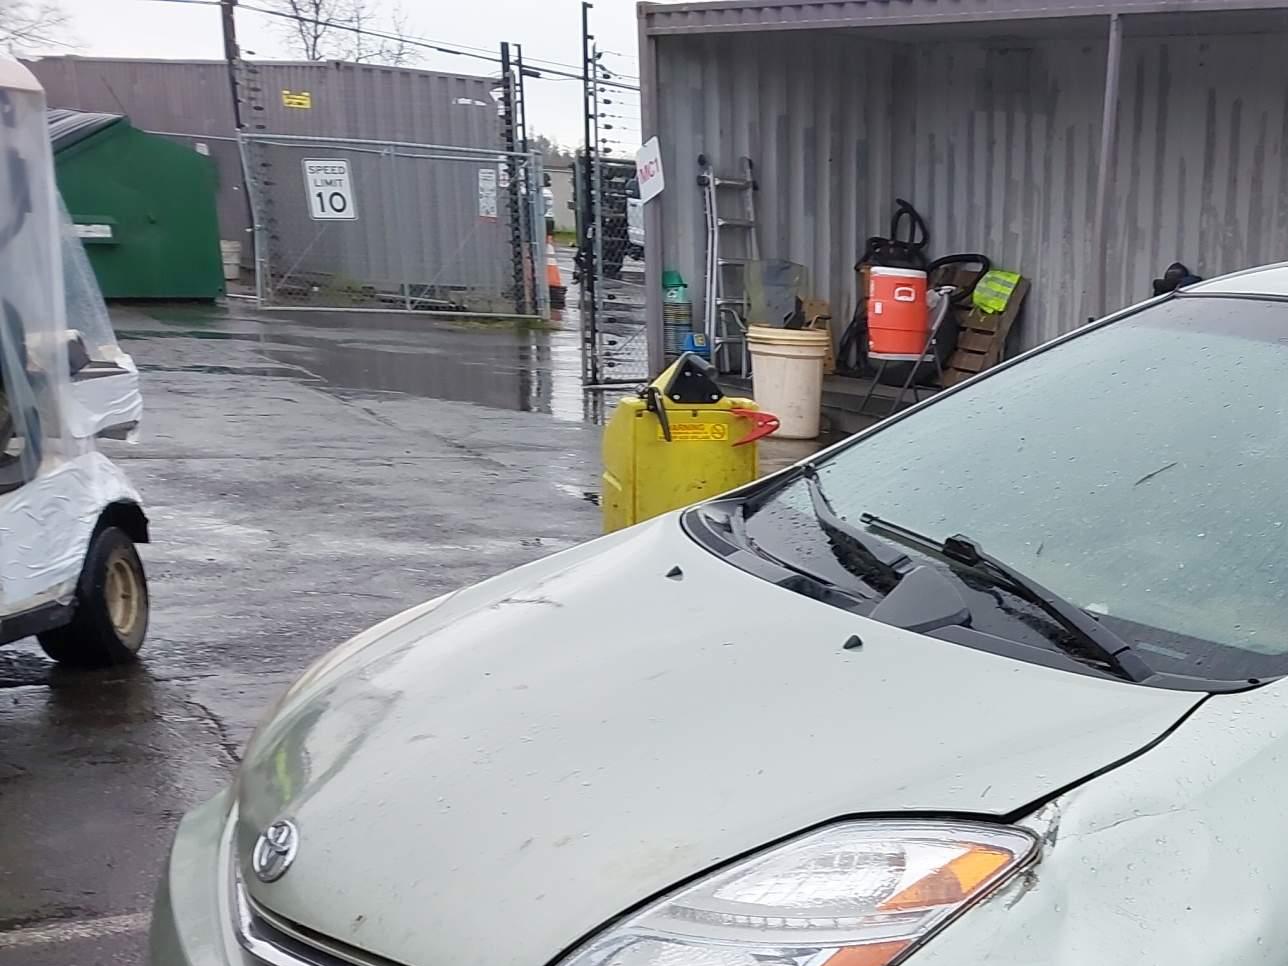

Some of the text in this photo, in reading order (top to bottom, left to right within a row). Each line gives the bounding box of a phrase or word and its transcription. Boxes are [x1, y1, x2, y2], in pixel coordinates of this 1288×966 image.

[308, 165, 345, 175] SPEED
[313, 178, 344, 188] LIMIT
[315, 191, 347, 213] 10
